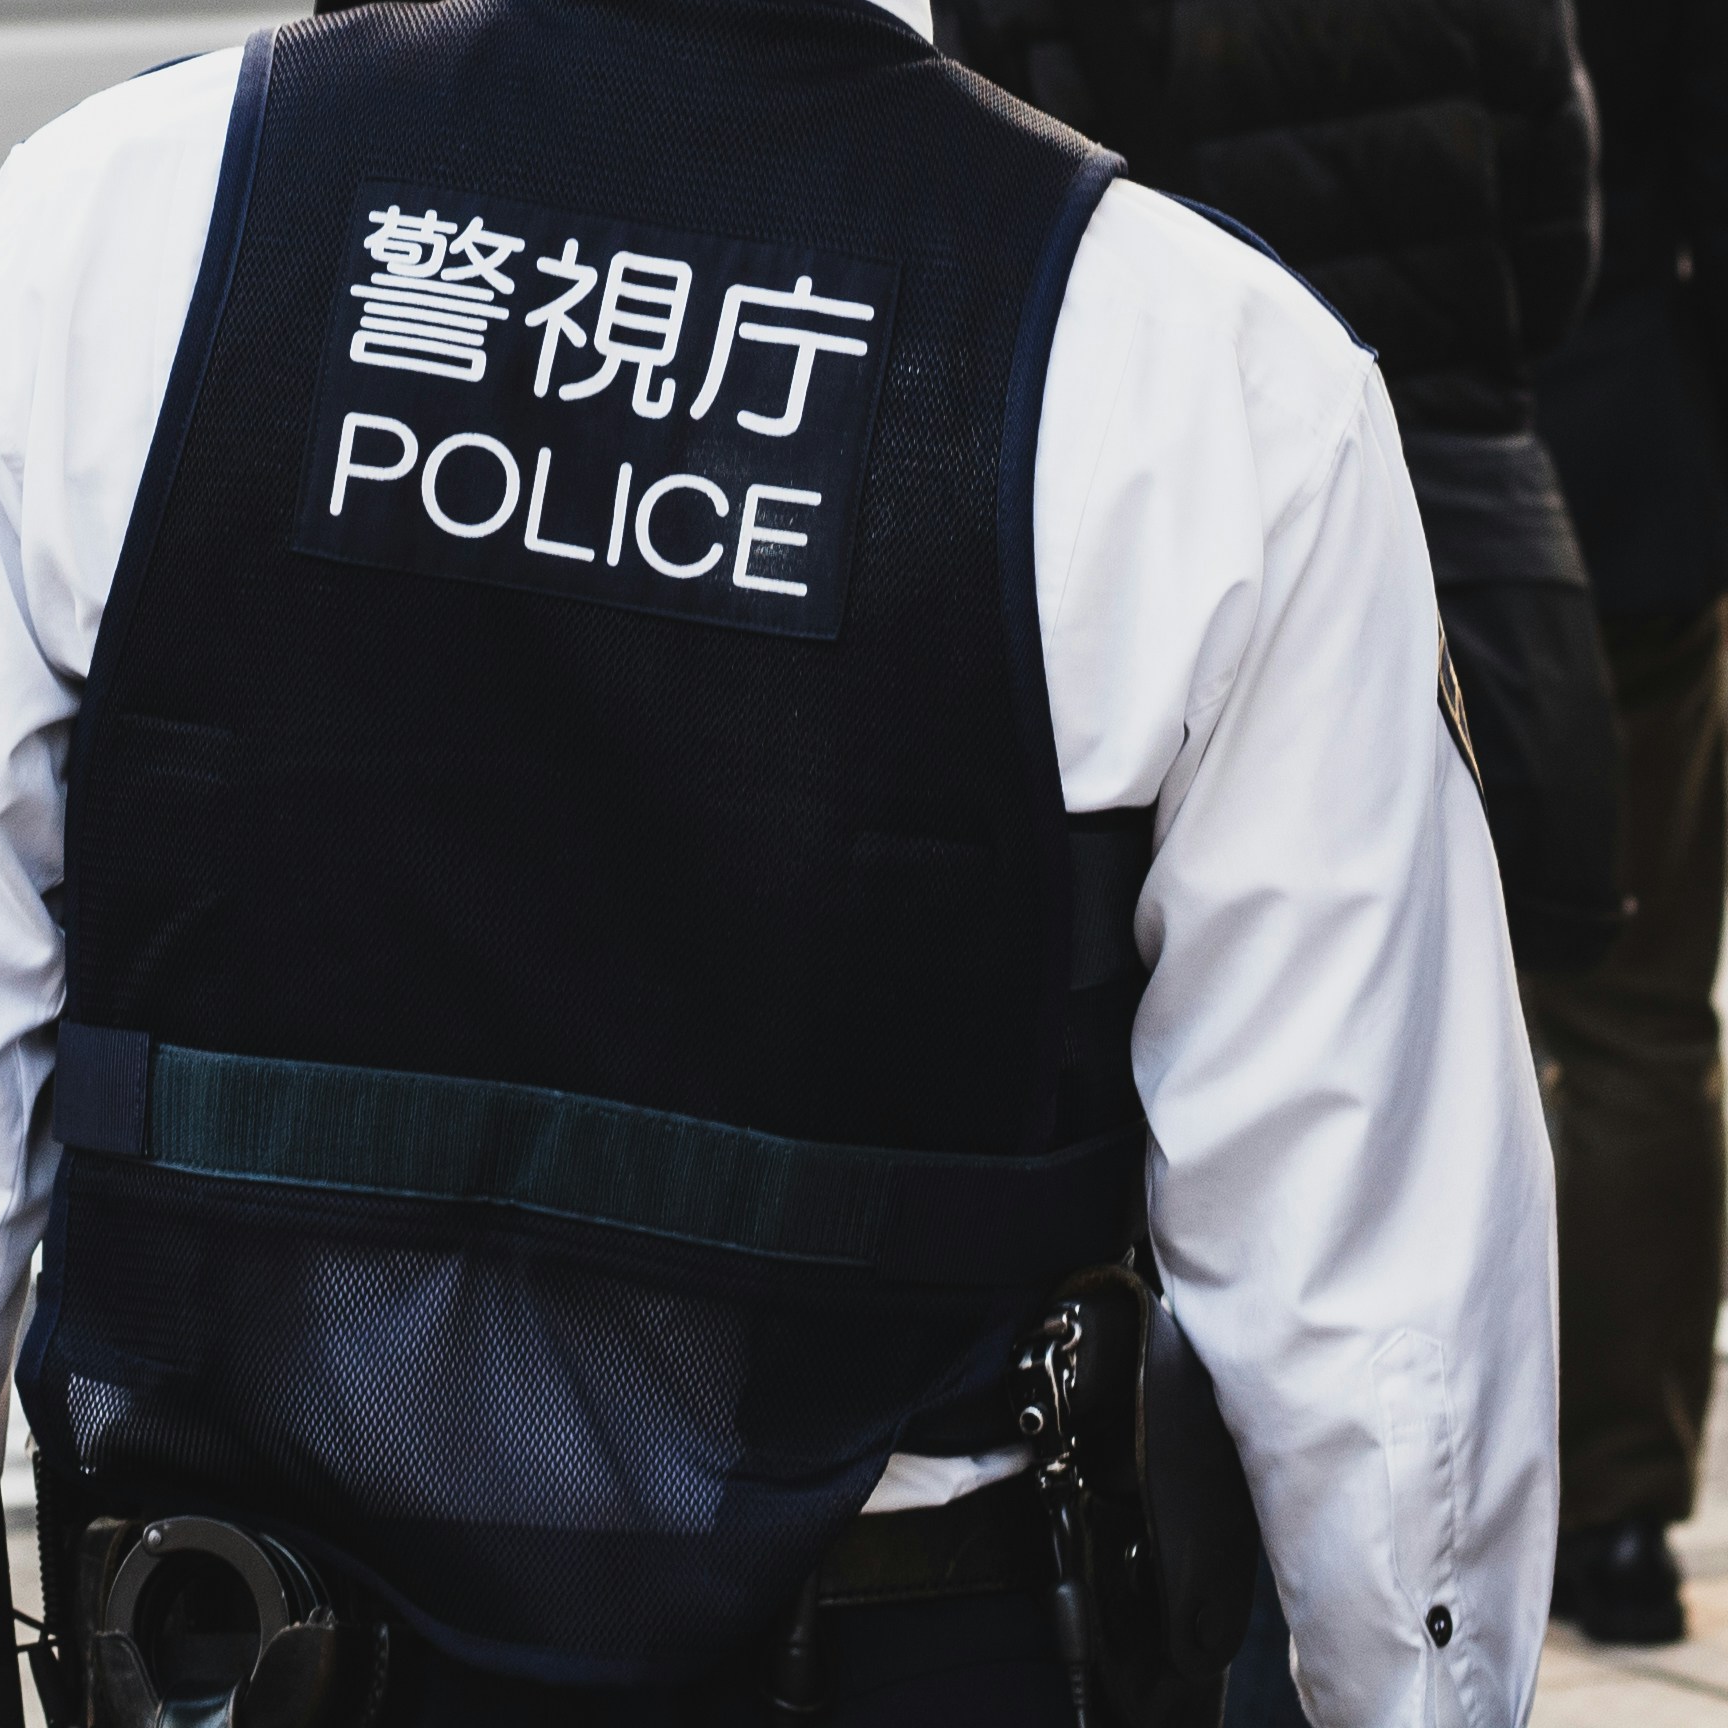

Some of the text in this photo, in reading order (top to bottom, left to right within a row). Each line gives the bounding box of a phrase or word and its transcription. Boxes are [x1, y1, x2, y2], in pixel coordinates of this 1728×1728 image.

[349, 203, 876, 439] 警視庁
[328, 410, 823, 598] POLICE
